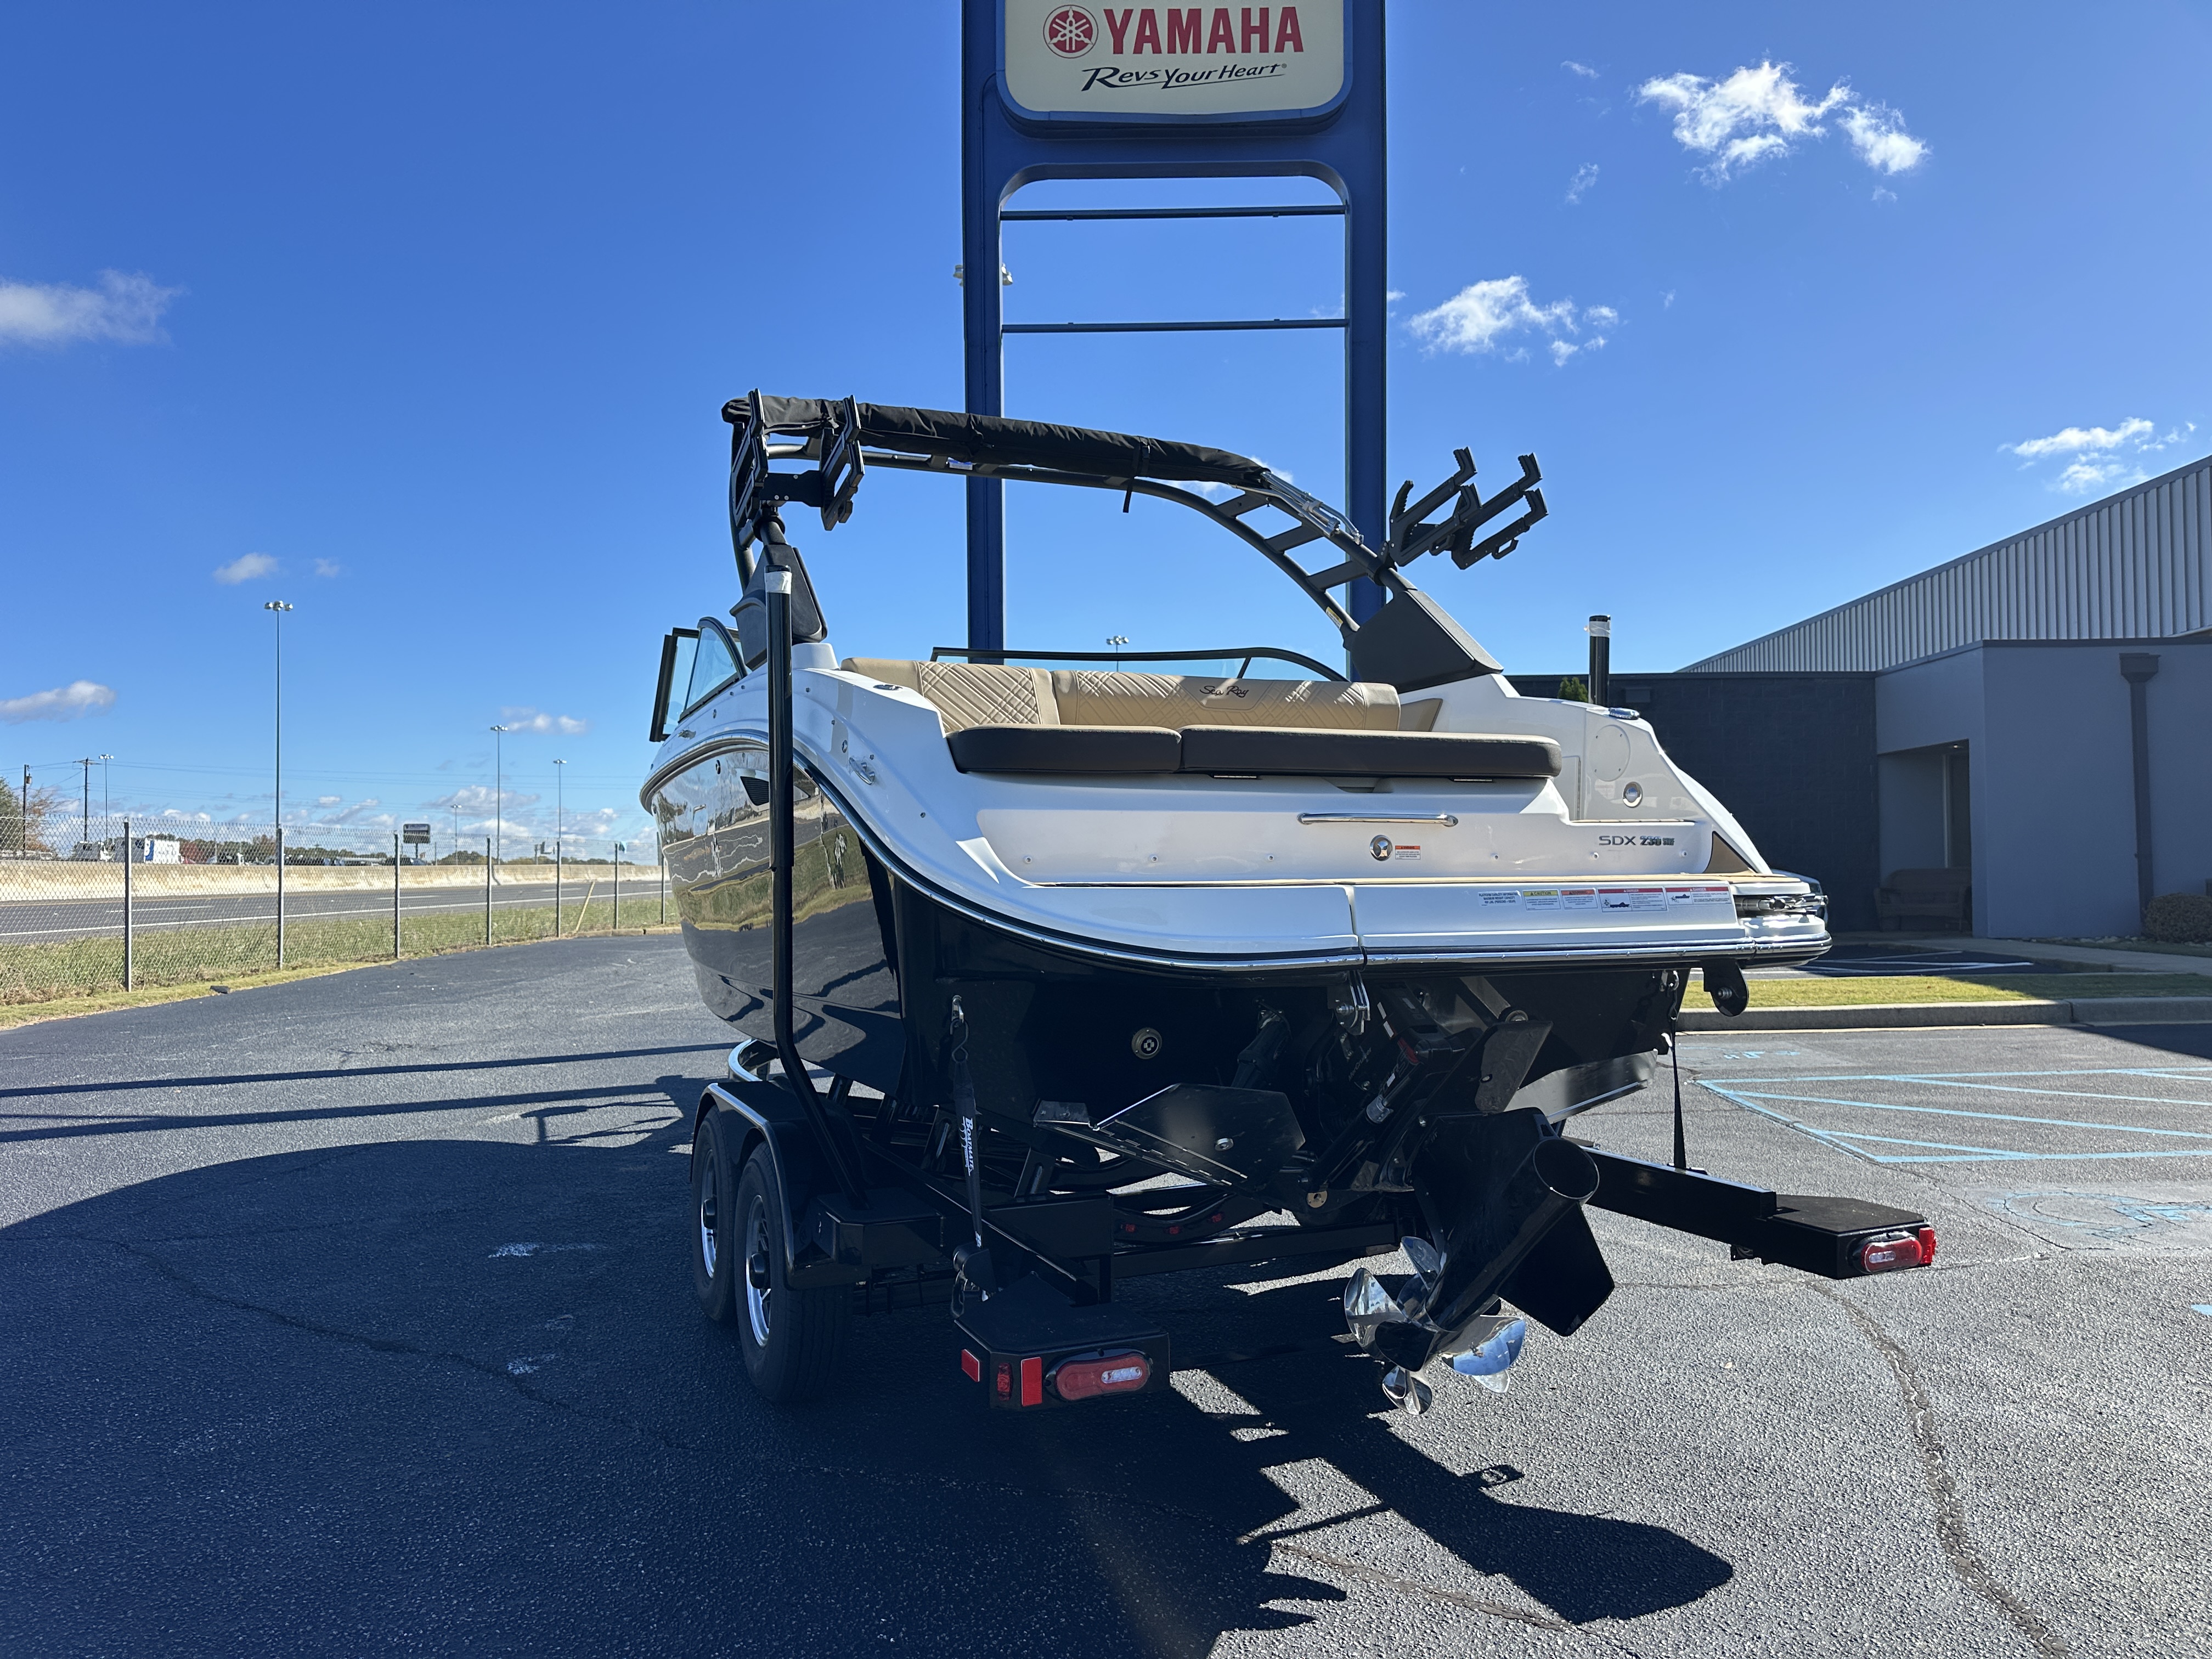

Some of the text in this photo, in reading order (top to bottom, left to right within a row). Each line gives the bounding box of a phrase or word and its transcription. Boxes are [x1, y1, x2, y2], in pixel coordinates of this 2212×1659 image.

[1103, 7, 1304, 54] YAMAHA
[1081, 67, 1161, 92] Revs
[1161, 68, 1217, 89] Your
[1200, 685, 1249, 698] Sea Ray
[1599, 836, 1636, 845] SDX
[1640, 836, 1661, 845] 230
